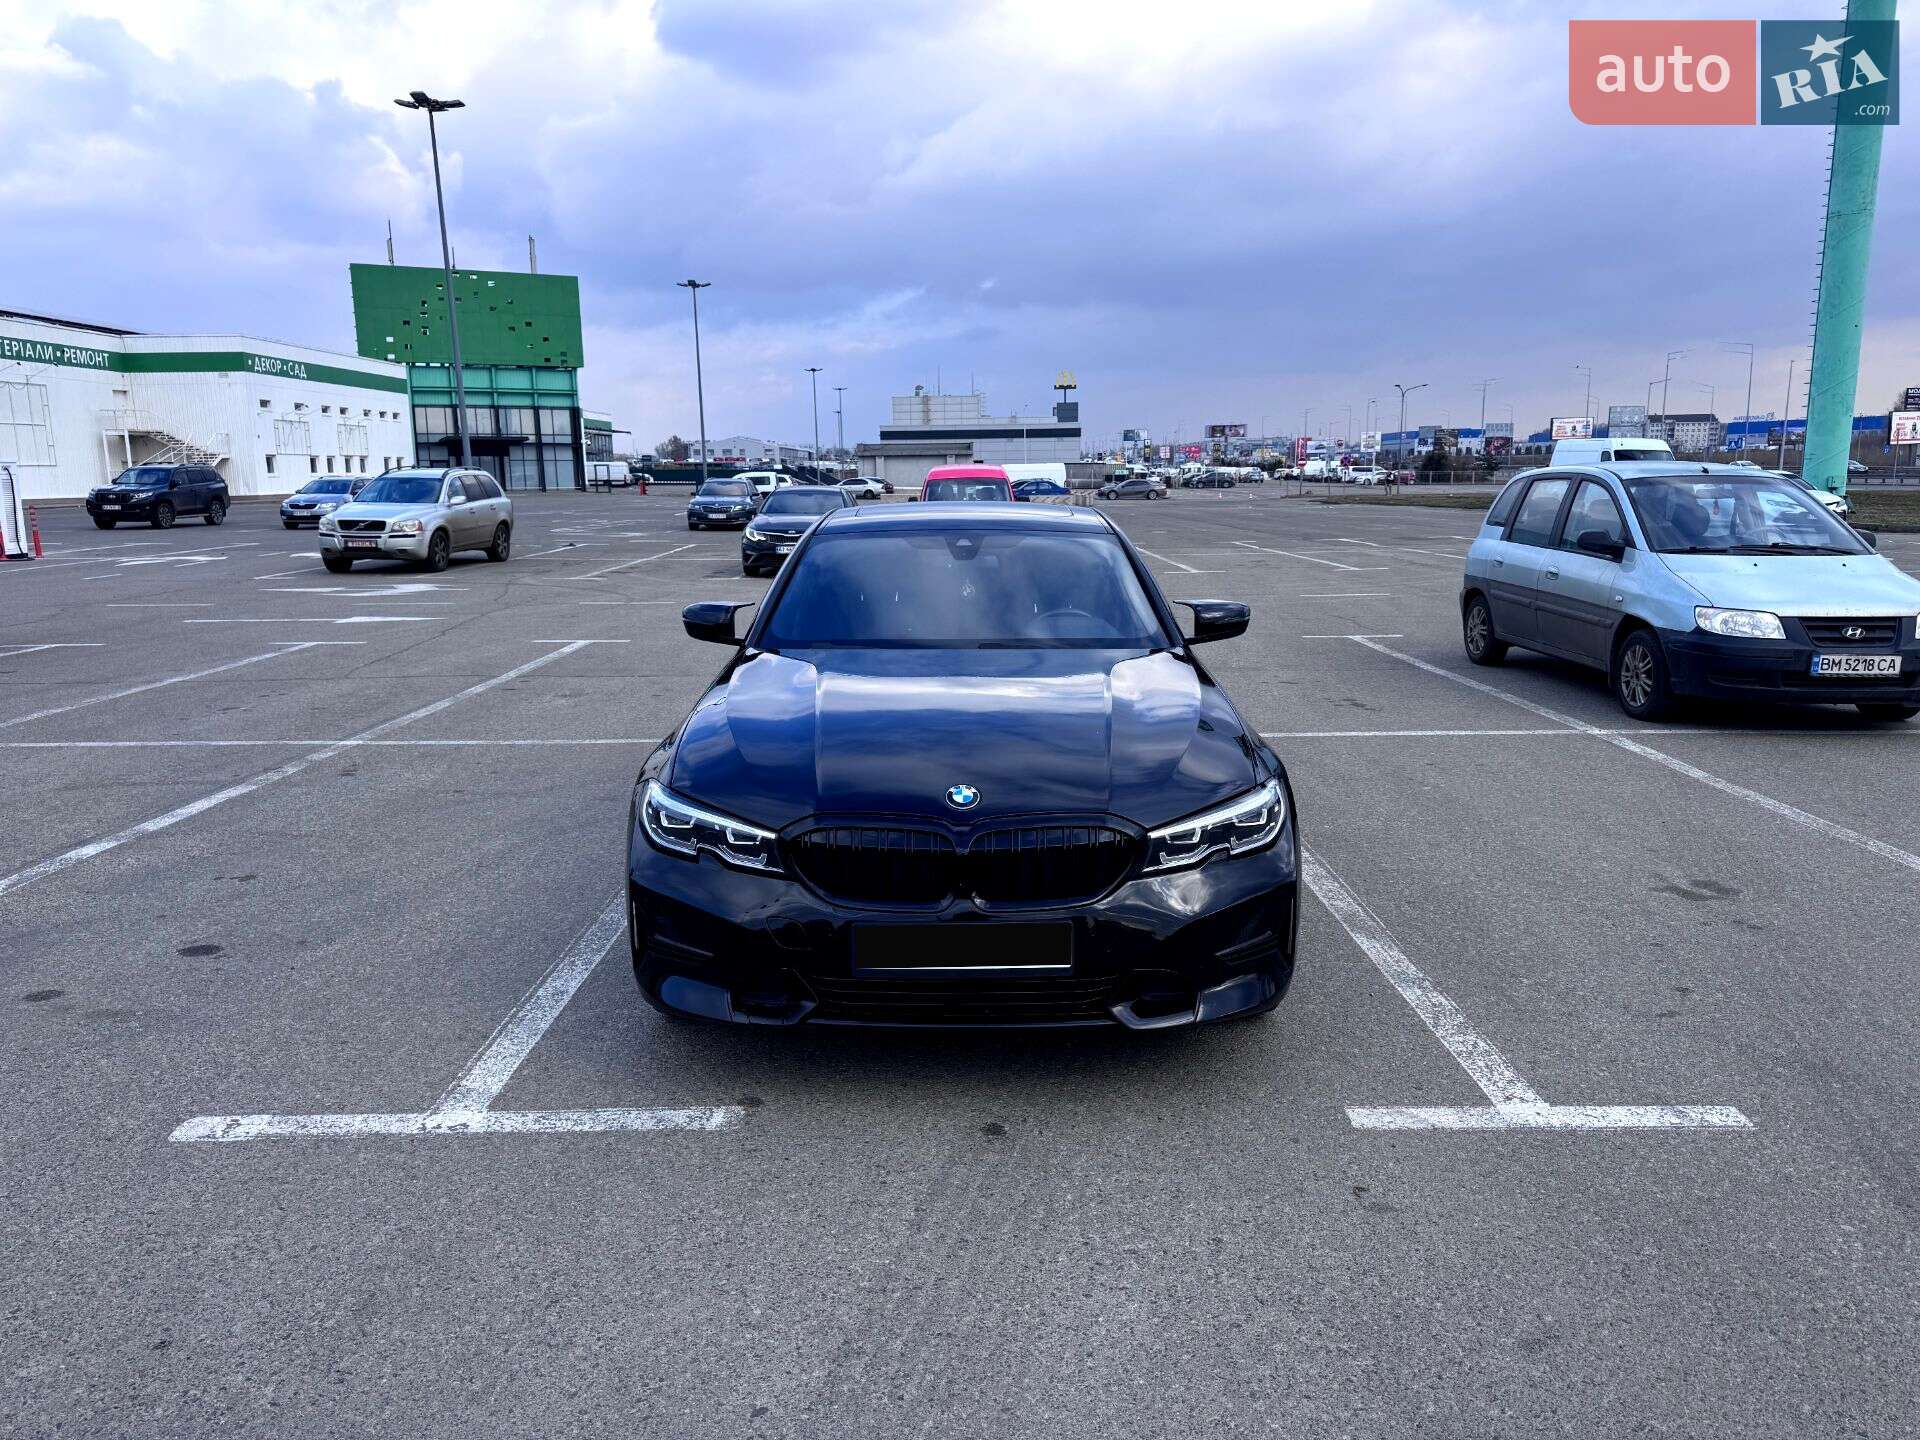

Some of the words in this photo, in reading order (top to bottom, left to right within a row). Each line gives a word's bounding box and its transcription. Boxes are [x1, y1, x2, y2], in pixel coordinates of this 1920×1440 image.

[63, 346, 110, 368] РЕМОНТ
[254, 356, 282, 374] ДЕКОР
[288, 361, 308, 379] САД
[1820, 657, 1842, 672] BM
[1843, 657, 1876, 673] 5218
[1877, 657, 1897, 672] CA
